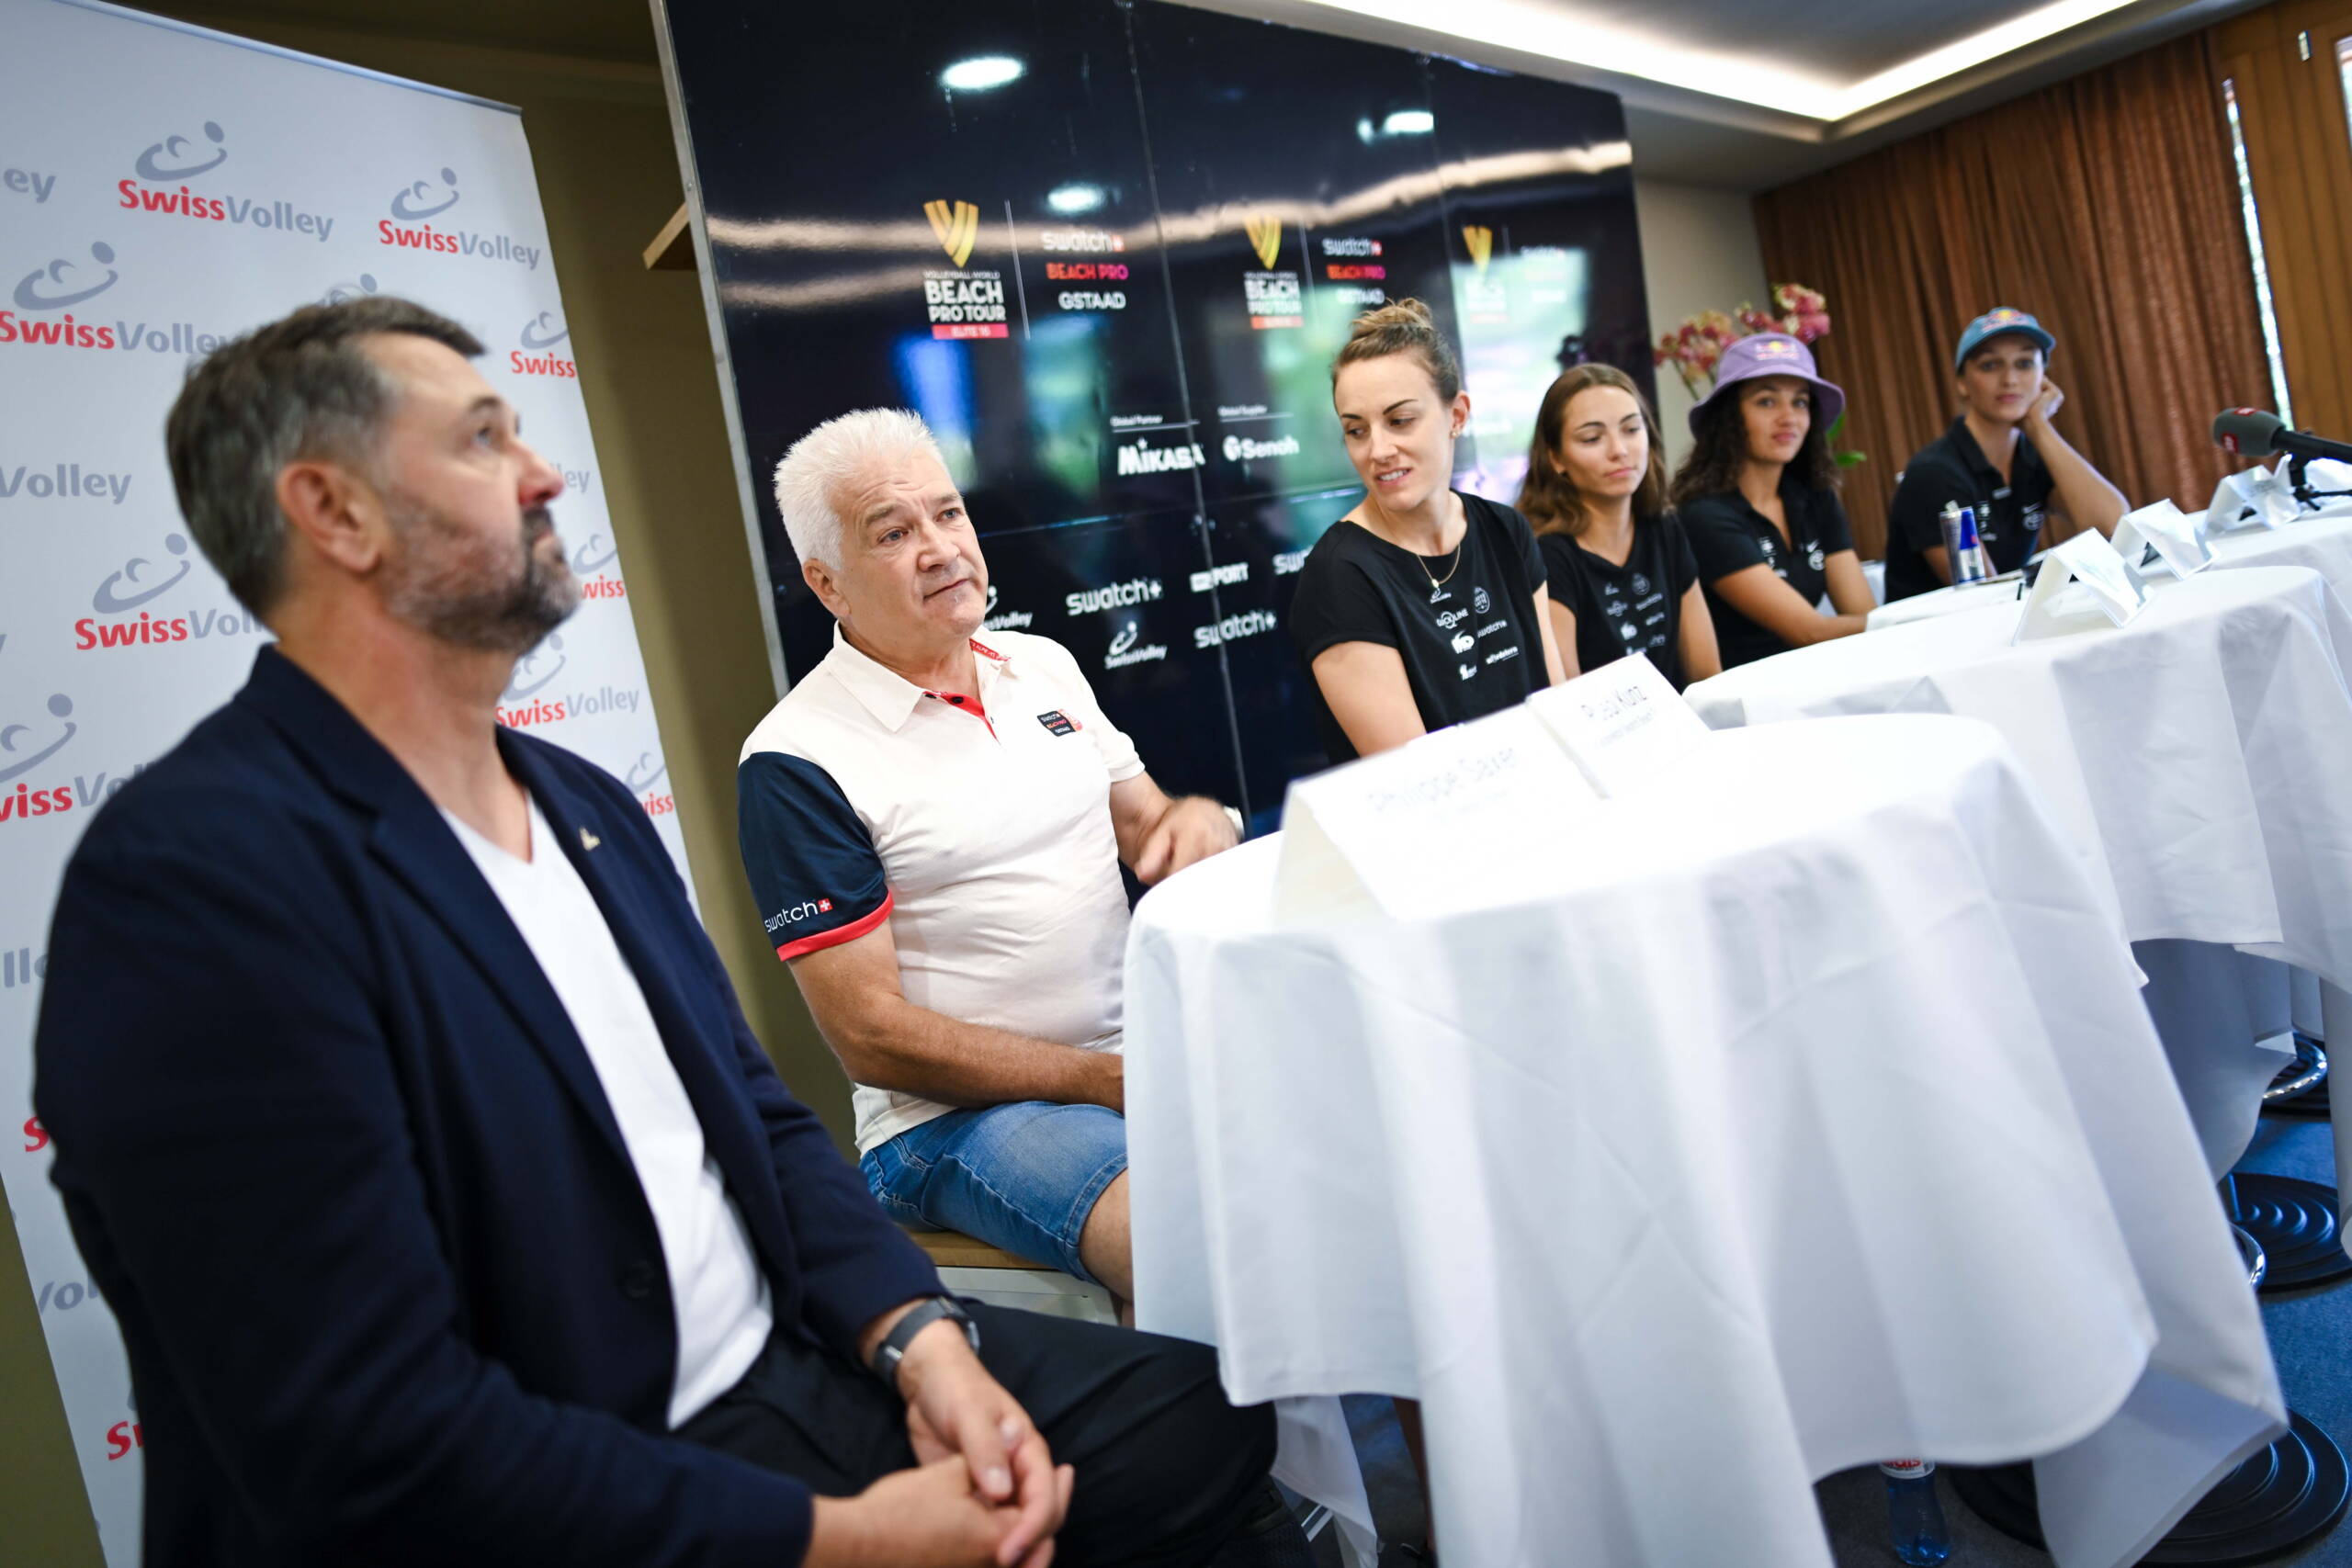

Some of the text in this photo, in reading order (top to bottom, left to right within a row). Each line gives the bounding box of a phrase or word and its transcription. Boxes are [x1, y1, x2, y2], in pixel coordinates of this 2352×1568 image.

[118, 179, 334, 243] SwissVolley
[379, 219, 540, 270] SwissVolley
[1046, 263, 1129, 280] BEACH PRO
[924, 279, 1004, 304] BEACH
[1058, 292, 1126, 310] GSTAAD
[928, 304, 1006, 322] PRO TOUR
[763, 901, 819, 932] swatch
